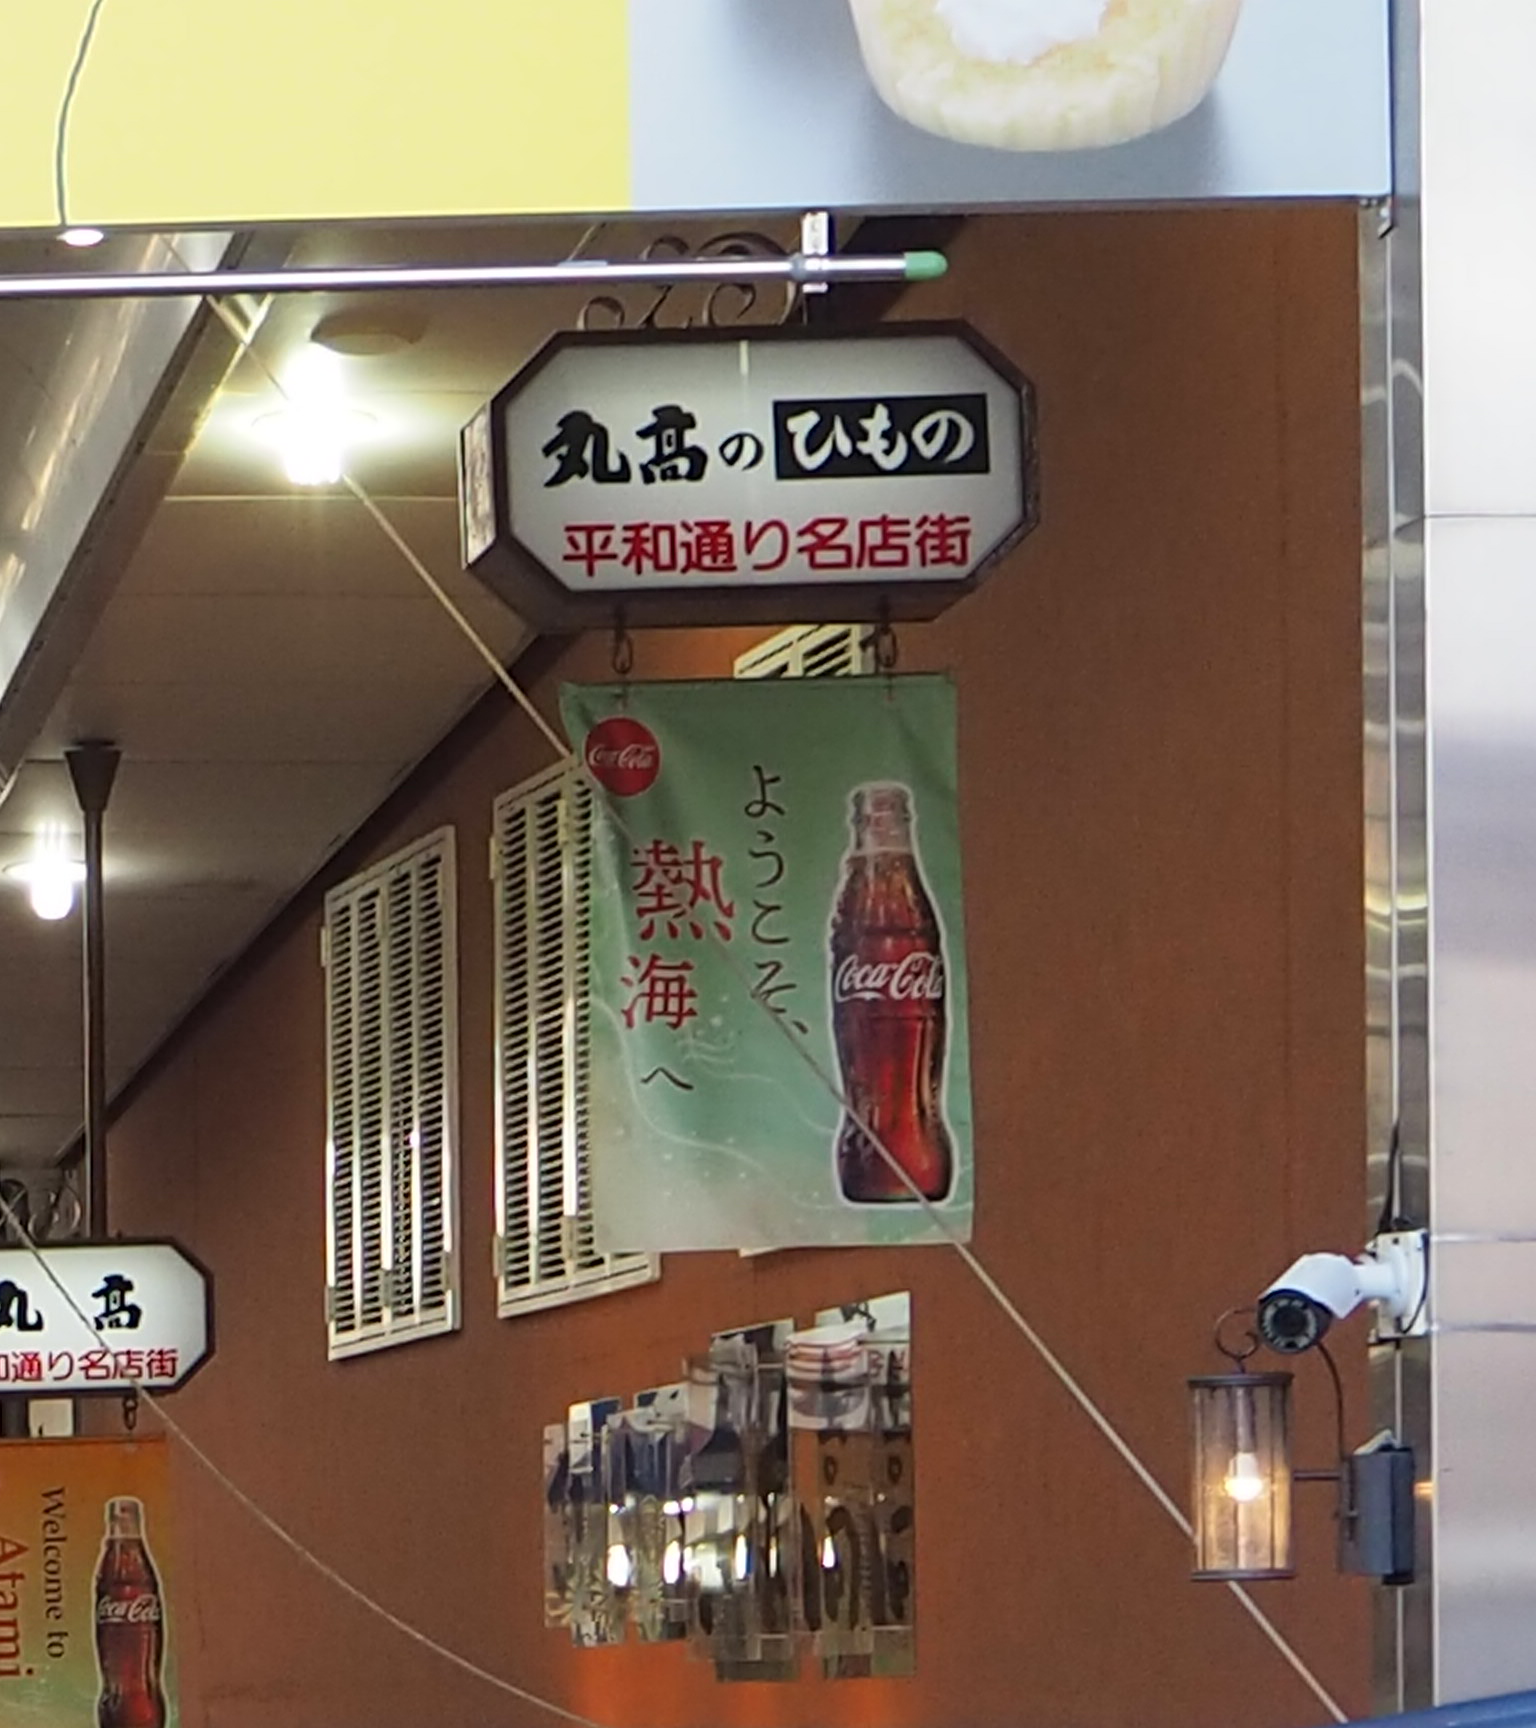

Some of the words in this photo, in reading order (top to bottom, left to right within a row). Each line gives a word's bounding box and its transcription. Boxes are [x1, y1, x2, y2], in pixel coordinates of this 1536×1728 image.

[562, 513, 971, 577] 平和通り名店街
[40, 1486, 68, 1621] Welcome
[45, 1630, 68, 1659] to
